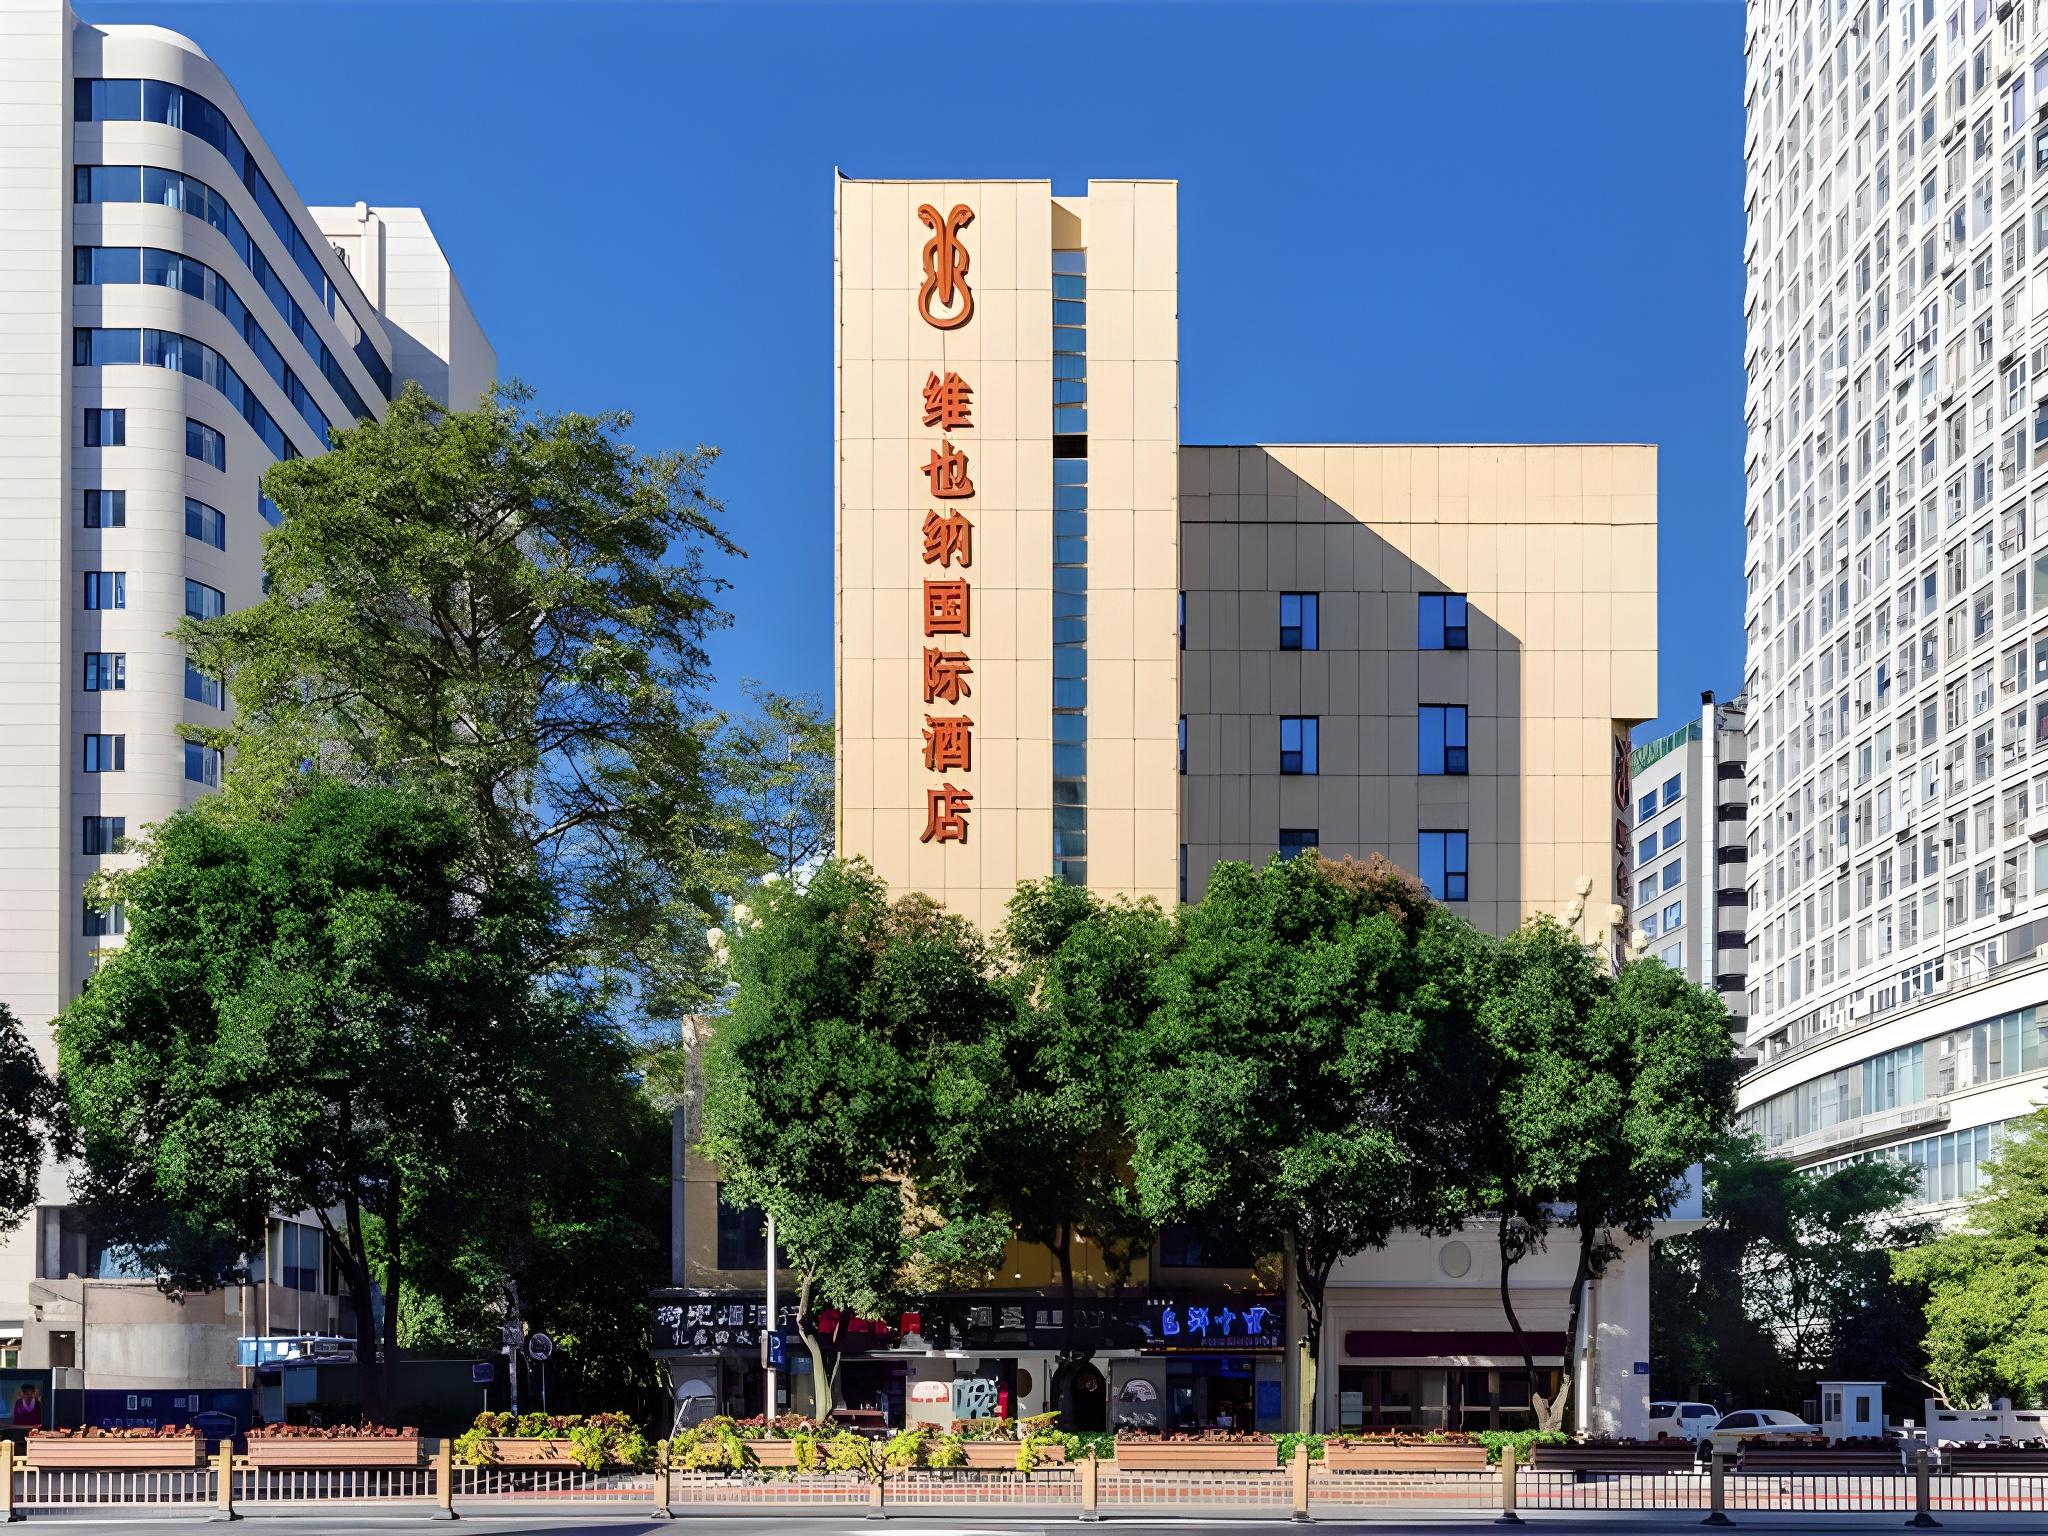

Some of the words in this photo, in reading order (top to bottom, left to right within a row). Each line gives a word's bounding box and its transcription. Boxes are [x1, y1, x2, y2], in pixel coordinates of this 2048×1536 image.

[920, 370, 976, 844] 维也纳国际酒店
